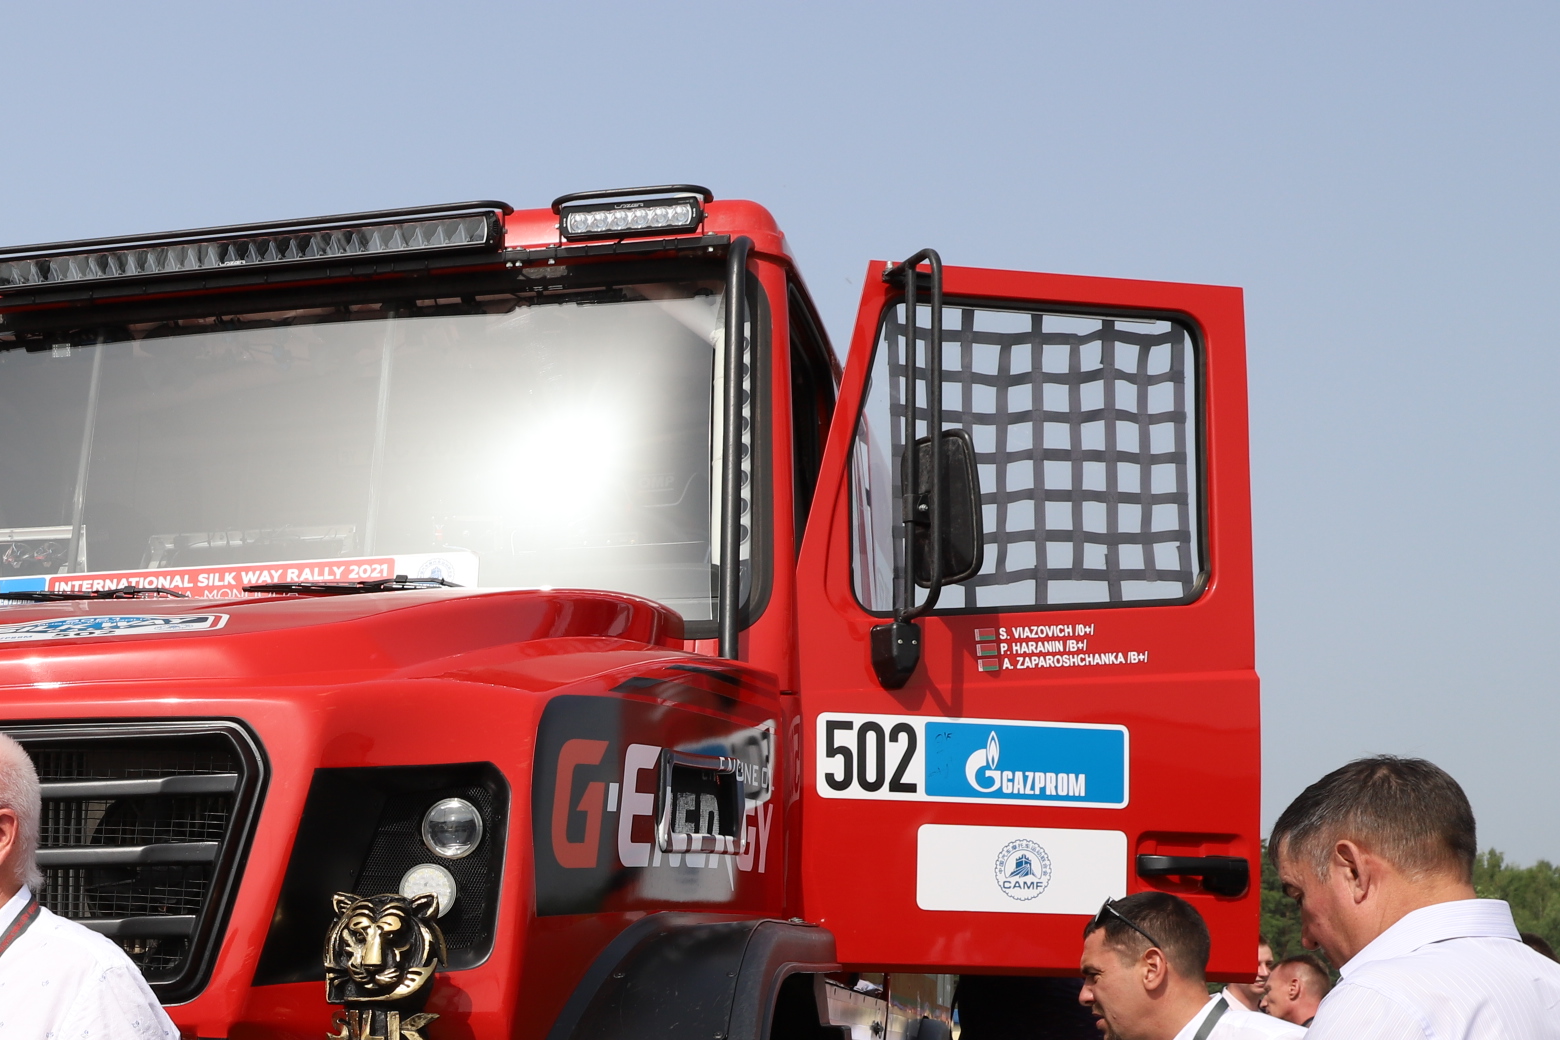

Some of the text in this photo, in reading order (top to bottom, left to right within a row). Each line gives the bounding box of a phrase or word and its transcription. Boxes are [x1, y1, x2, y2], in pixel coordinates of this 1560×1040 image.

[55, 563, 388, 592] INTERNATIONAL SILK WAY RALLY 2021
[999, 627, 1010, 640] S.
[1012, 625, 1073, 639] VIAZOVICH
[1000, 643, 1011, 655] P.
[1013, 641, 1064, 654] HARANIN
[1002, 658, 1013, 670] A.
[1017, 653, 1125, 669] ZAPAROSHCHANKA
[824, 719, 918, 793] 502
[1002, 880, 1043, 890] CAMF
